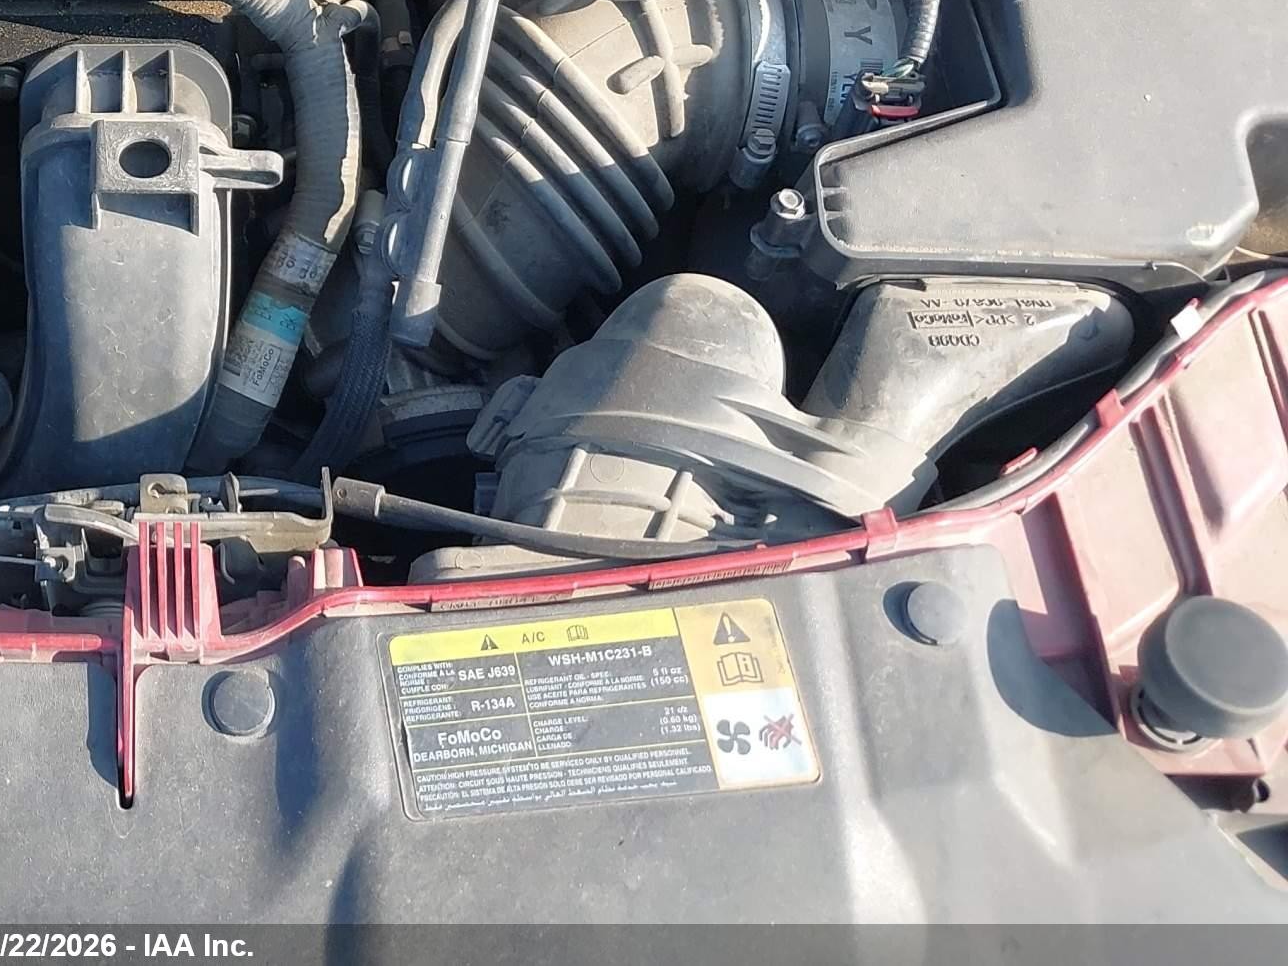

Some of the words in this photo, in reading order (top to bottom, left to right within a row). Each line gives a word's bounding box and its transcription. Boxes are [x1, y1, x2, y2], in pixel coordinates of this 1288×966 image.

[844, 25, 873, 46] Y
[252, 347, 275, 386] FoMoCo
[521, 631, 546, 644] A/C
[548, 645, 653, 667] WSH-M1C231-B
[397, 663, 433, 673] COMPLIES
[458, 667, 486, 681] SAE
[488, 665, 516, 679] J639
[398, 670, 438, 681] CONFORME
[524, 674, 573, 685] REFRIGERANT
[650, 675, 672, 687] (150
[673, 674, 689, 684] cc)
[401, 685, 431, 694] CUMPLE
[567, 679, 604, 689] CONFORME
[527, 692, 542, 701] USE
[543, 690, 568, 700] ACEITE
[569, 688, 588, 697] PARA
[589, 682, 647, 695] REFRIGERANTES
[471, 696, 516, 712] R-134A
[529, 699, 569, 709] CONFORME
[663, 706, 675, 715] 21
[533, 718, 563, 728] CHARGE
[683, 713, 697, 724] kg)
[660, 725, 683, 735] (1.32
[683, 723, 700, 733] lbs)
[437, 727, 502, 745] FoMoCo
[536, 734, 562, 743] CARGA
[413, 747, 478, 762] DEARBORN,
[478, 740, 533, 755] MICHIGAN
[448, 771, 464, 780] HIGH
[465, 768, 501, 777] PRESSURE
[501, 764, 529, 774] SYSTEM
[530, 762, 540, 770] TO
[540, 761, 550, 769] BE
[550, 758, 584, 769] SERVICED
[584, 757, 602, 766] ONLY
[603, 756, 613, 764] BY
[614, 752, 649, 762] QUALIFIED
[458, 779, 485, 788] CIRCUIT
[485, 777, 505, 786] SOUS
[506, 774, 529, 783] HAUTE
[529, 770, 563, 781] PRESSION
[567, 766, 612, 777] TECHNICIENS
[470, 787, 498, 797] SISTEMA
[506, 784, 522, 793] ALTA
[566, 777, 584, 786] DEBE
[584, 776, 597, 784] SER
[597, 773, 628, 783] REVISADO
[628, 772, 642, 780] POR
[642, 768, 675, 779] PERSONAL
